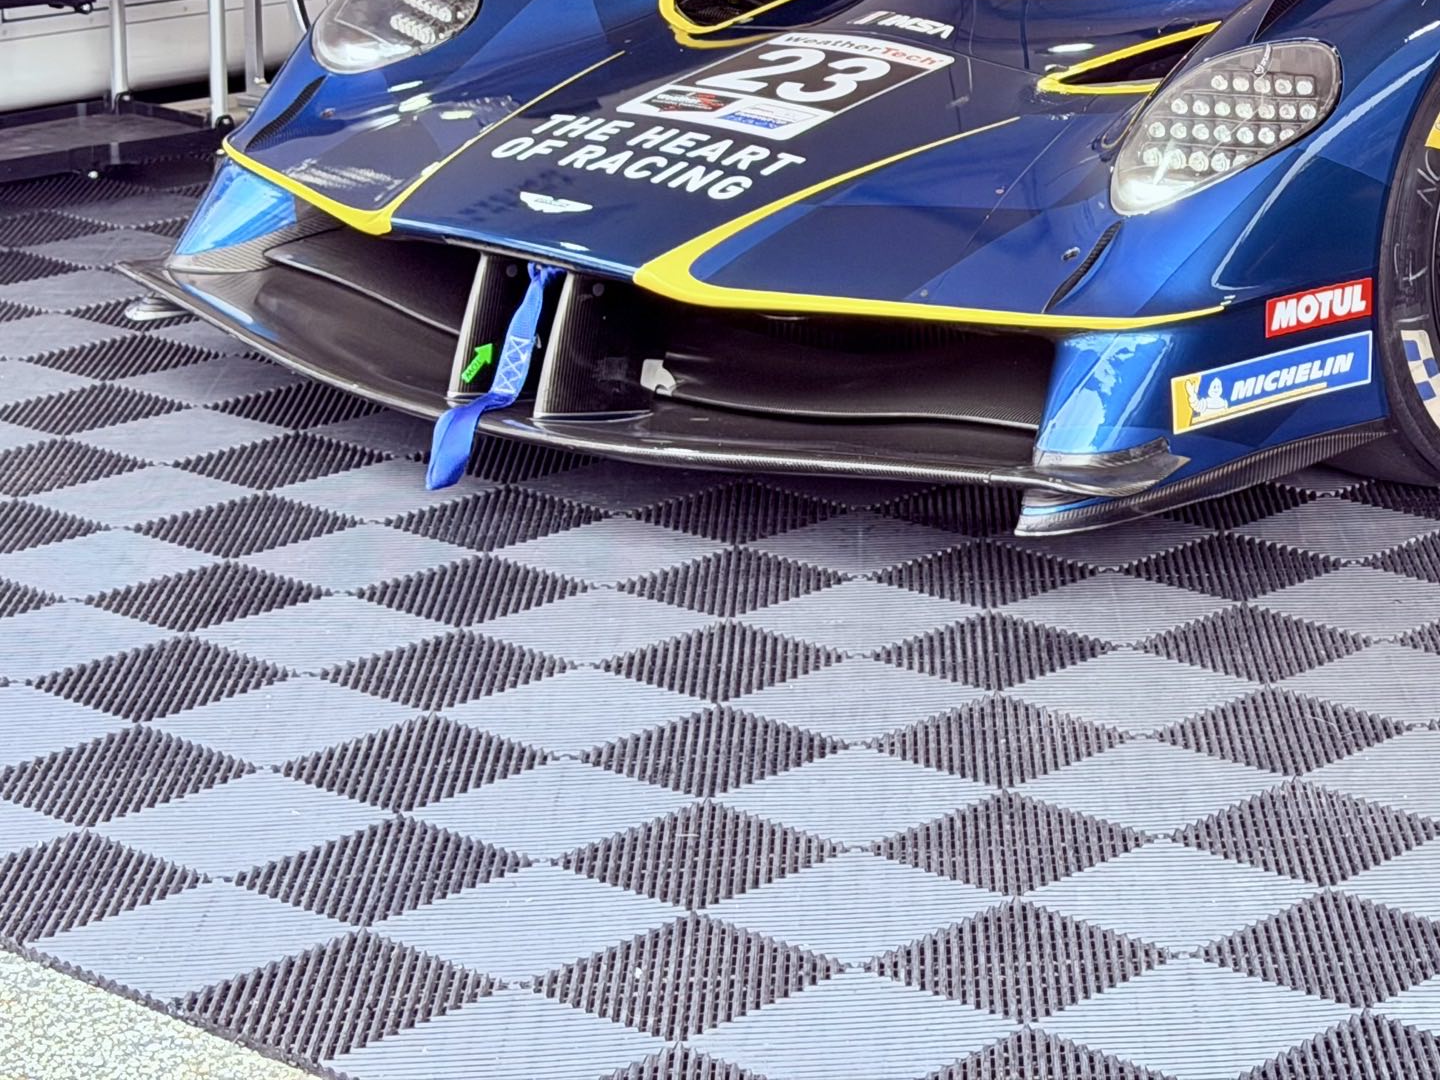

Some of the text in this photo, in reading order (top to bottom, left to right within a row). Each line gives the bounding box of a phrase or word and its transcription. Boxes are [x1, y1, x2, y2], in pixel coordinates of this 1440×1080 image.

[785, 36, 943, 66] WeatherTech
[878, 14, 954, 39] IMSA
[696, 48, 892, 103] 23
[491, 137, 754, 200] OF RACING
[530, 114, 806, 176] THE HEART
[1271, 284, 1366, 331] MOTUL
[1230, 352, 1354, 402] MICHELIN
